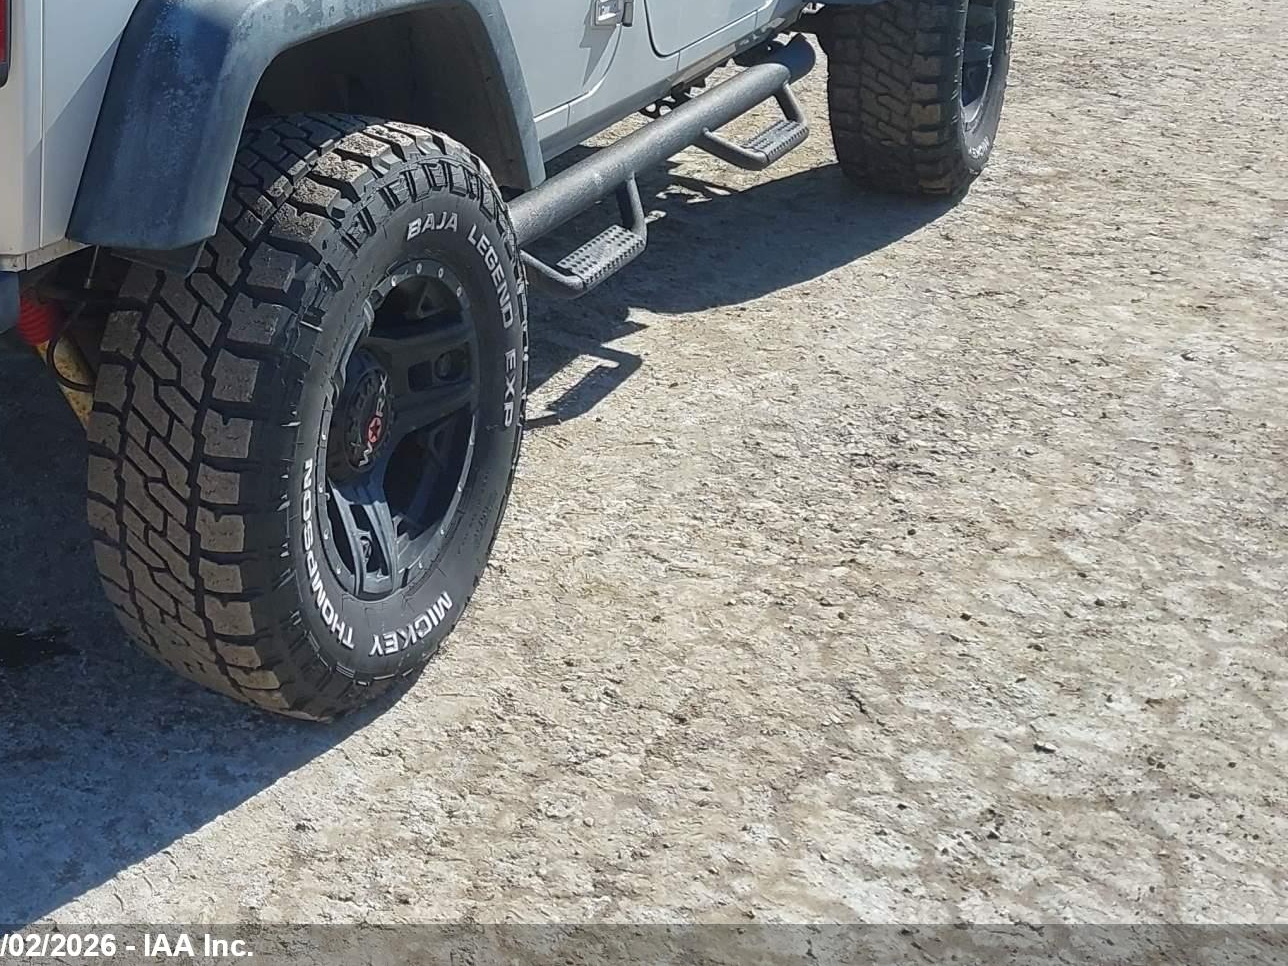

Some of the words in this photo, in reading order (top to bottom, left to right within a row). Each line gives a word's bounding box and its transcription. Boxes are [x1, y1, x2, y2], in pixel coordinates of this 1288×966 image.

[407, 211, 459, 241] BAJA
[467, 224, 513, 329] LEGEND
[504, 349, 516, 427] EXP
[302, 458, 355, 650] THOMPSON
[368, 591, 454, 657] MICKEY
